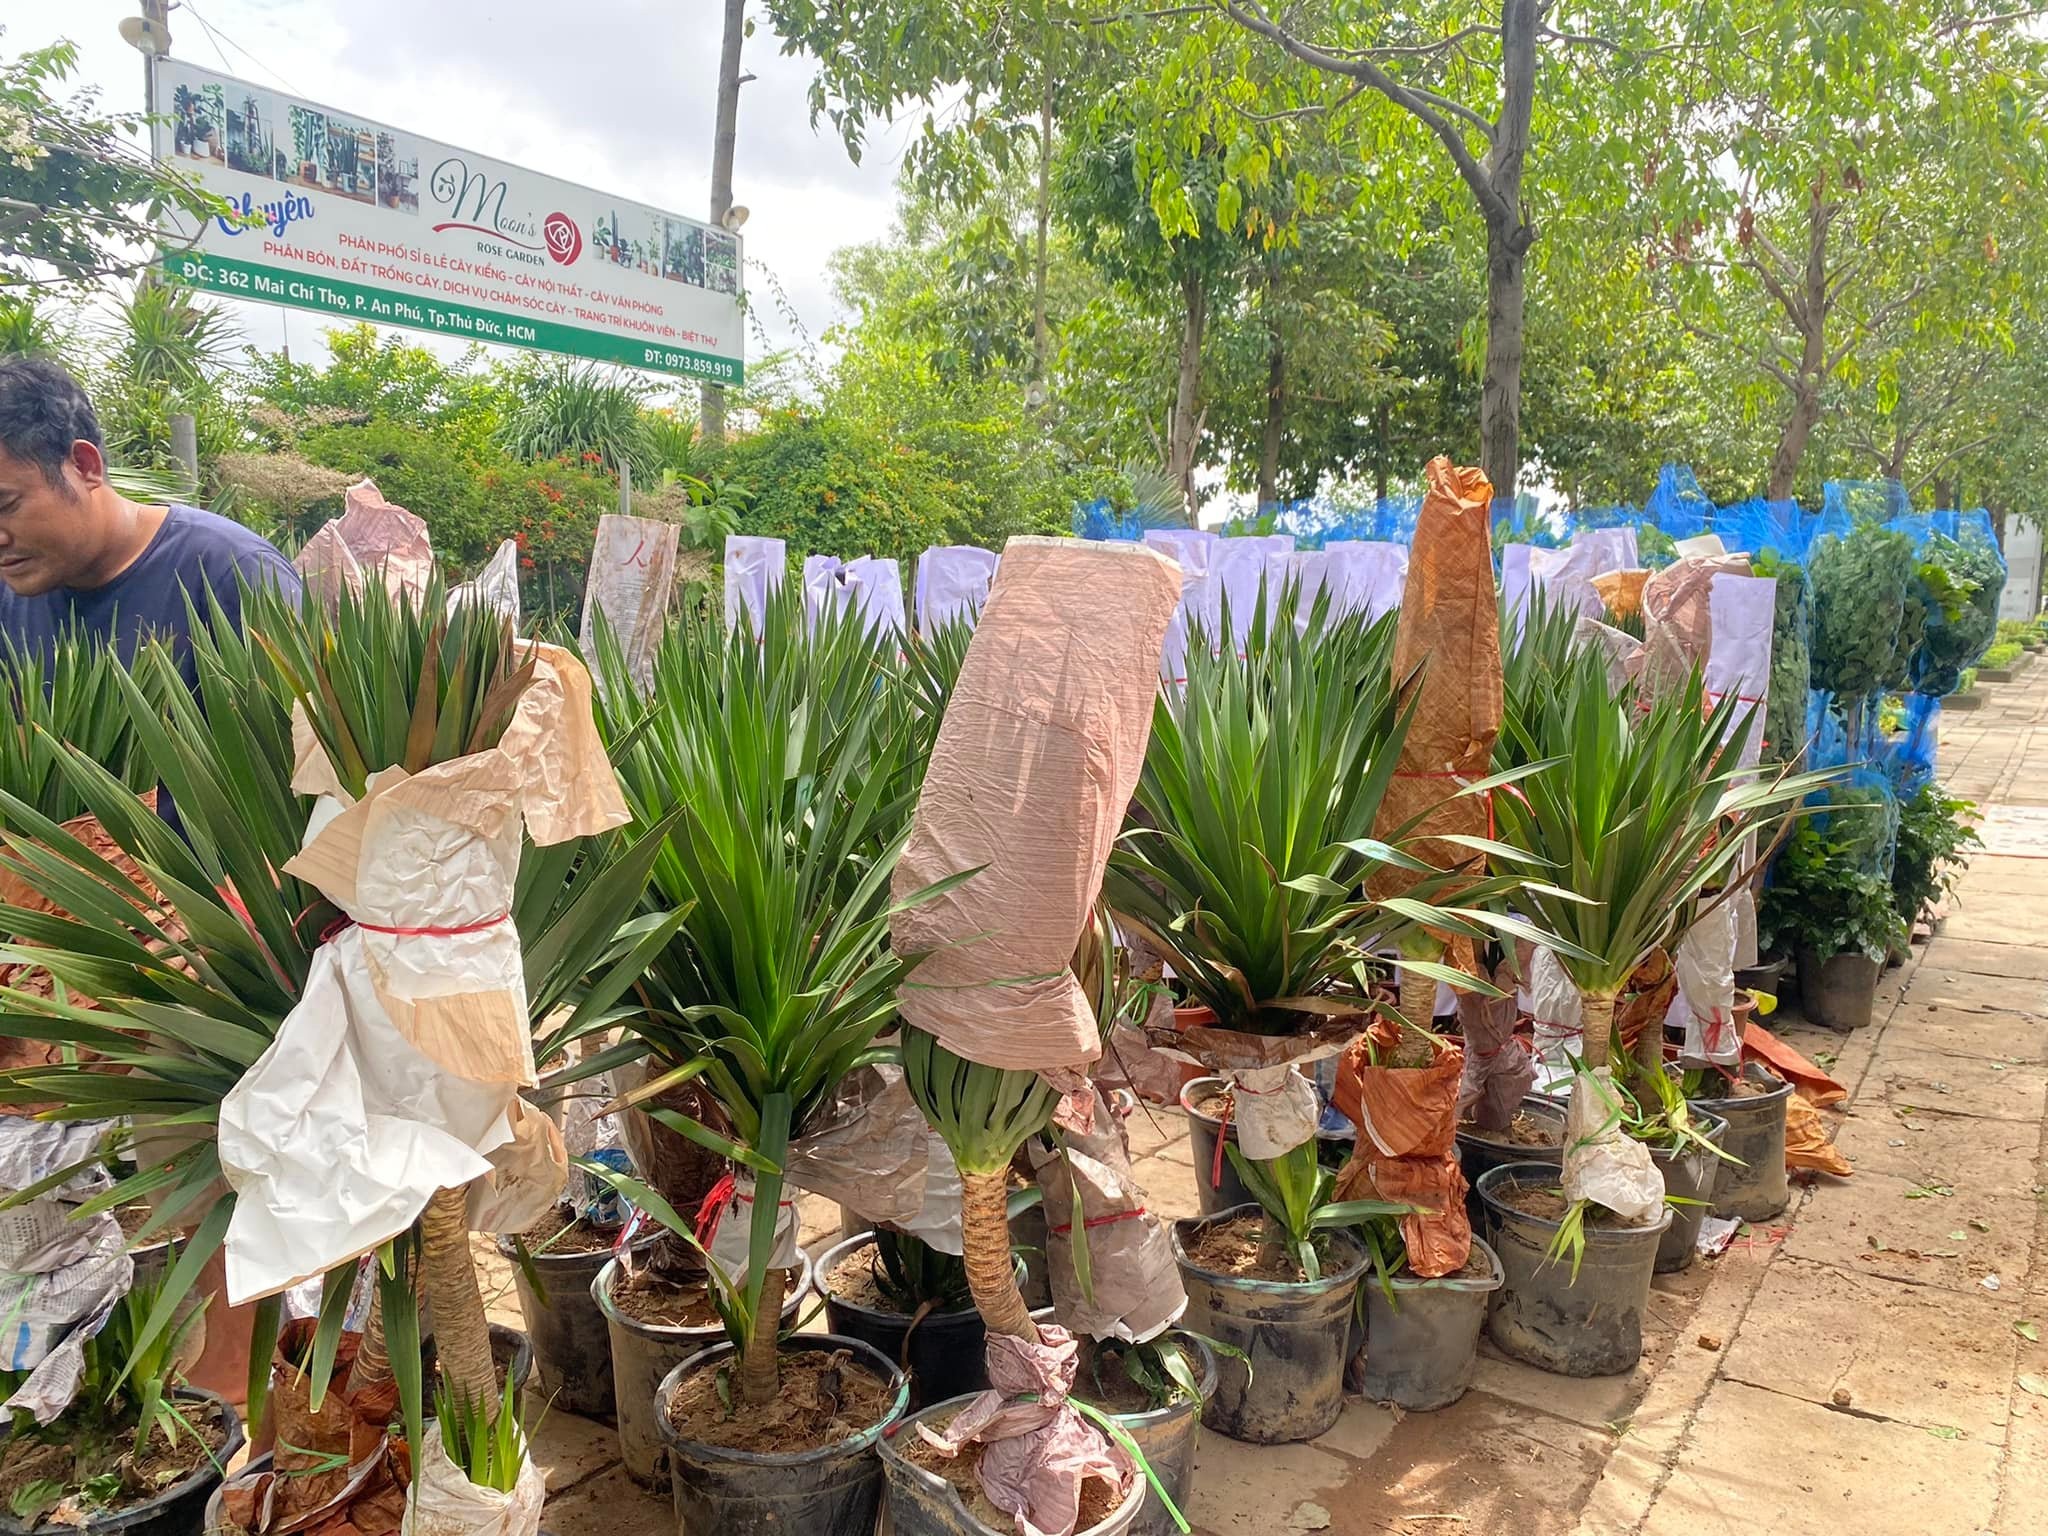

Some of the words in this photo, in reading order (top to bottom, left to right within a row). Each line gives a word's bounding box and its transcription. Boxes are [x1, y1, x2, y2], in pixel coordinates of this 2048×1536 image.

[431, 158, 536, 237] Moon's
[339, 234, 375, 253] PHÂN
[378, 242, 408, 260] PHỐI
[423, 253, 431, 265] &
[434, 252, 448, 269] LẺ
[450, 257, 472, 274] CÂY
[515, 273, 536, 288] CÂY
[538, 278, 555, 294] NỘI
[557, 283, 583, 298] THẤT
[590, 290, 609, 303] CÂY
[477, 241, 503, 257] ROSE
[505, 248, 545, 266] GARDEN
[182, 261, 213, 282] ĐC:
[218, 268, 249, 289] 362
[254, 275, 284, 295] Mai
[288, 282, 314, 300] Chí
[318, 287, 350, 309] Thọ,
[355, 294, 367, 311] P.
[371, 298, 391, 315] An
[395, 302, 424, 323] Phú,
[507, 324, 535, 341] HCM
[264, 241, 303, 260] PHÂN
[341, 256, 368, 274] ĐẤT
[443, 280, 470, 296] DỊCH
[471, 286, 487, 301] VỤ
[523, 296, 545, 311] SÓC
[546, 302, 566, 315] CÂY
[574, 307, 606, 323] TRANG
[623, 319, 655, 334] KHUÔN
[656, 325, 675, 338] VIÊN
[682, 330, 699, 344] BIỆT
[644, 348, 662, 365] ĐT:
[665, 352, 733, 378] 0973.859.919
